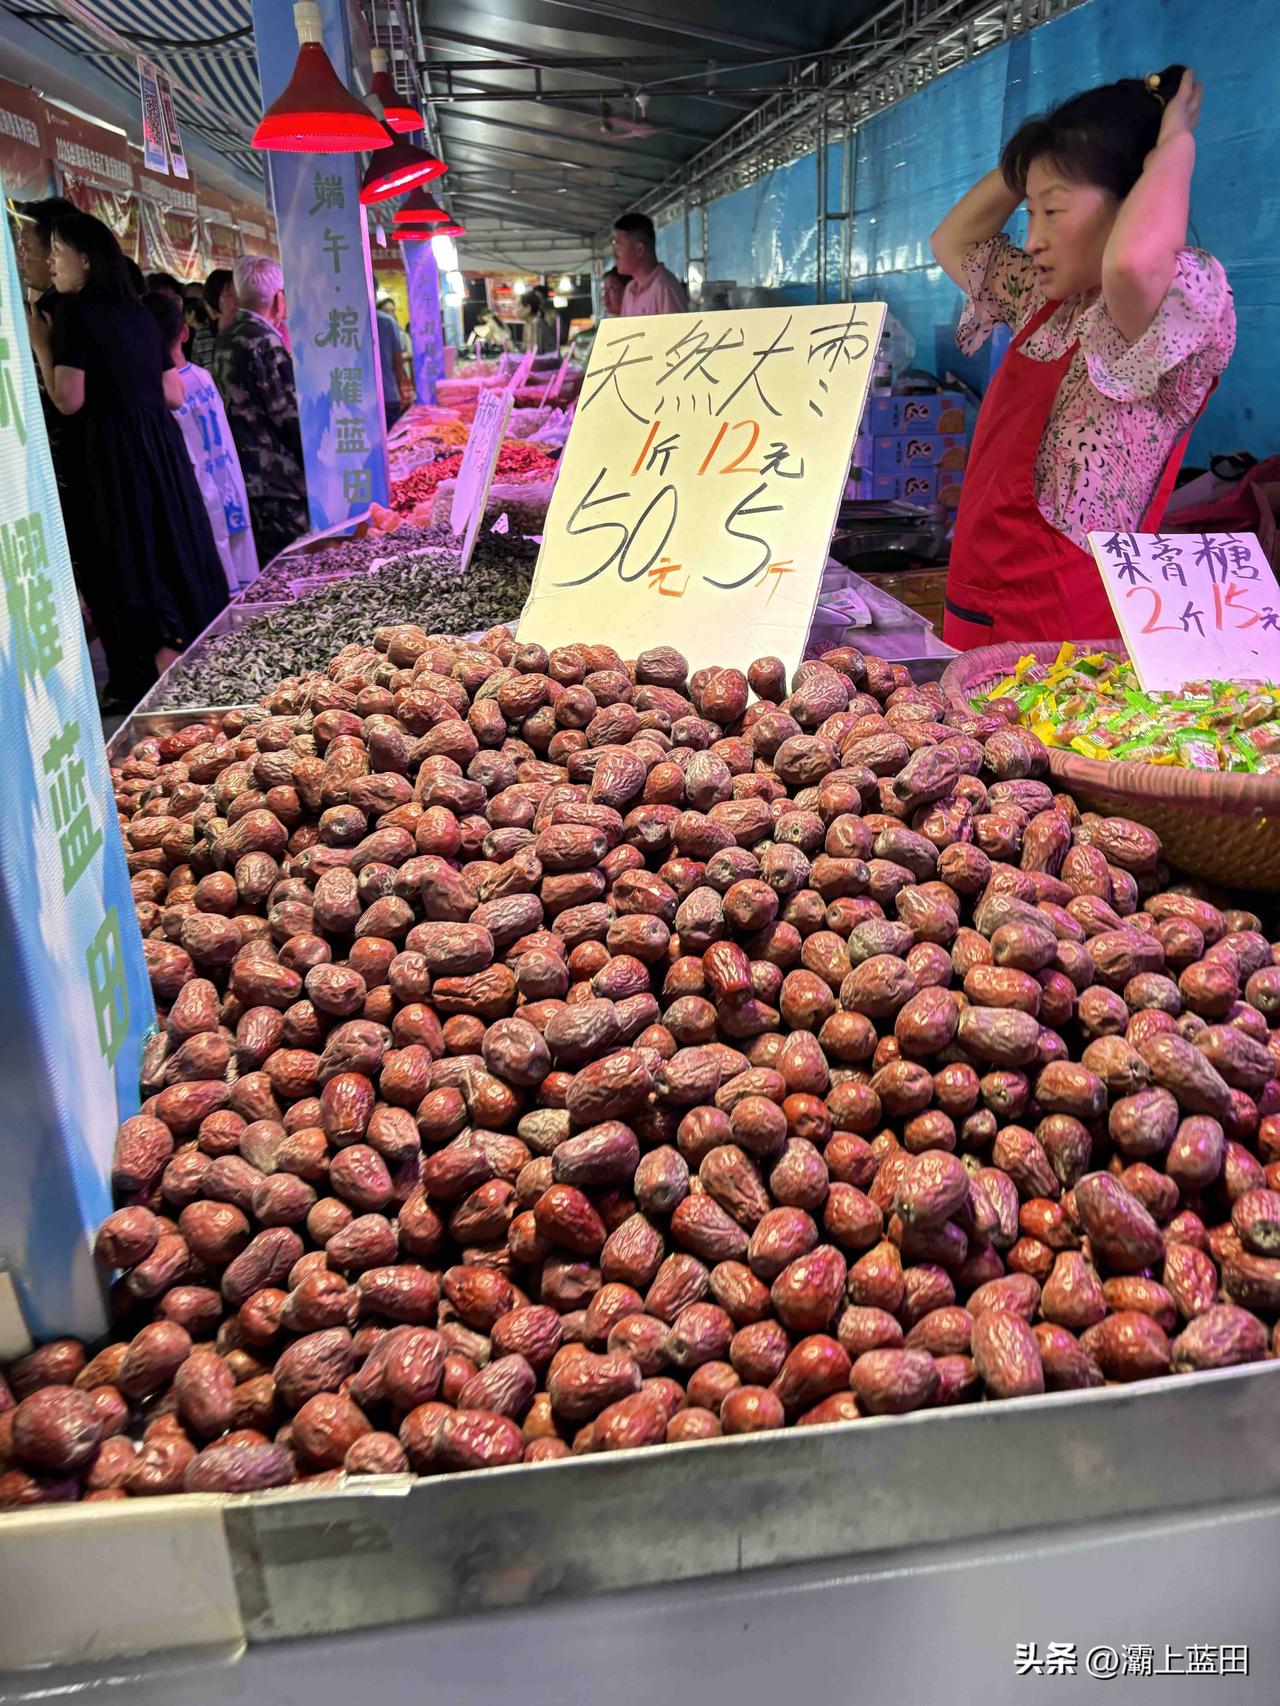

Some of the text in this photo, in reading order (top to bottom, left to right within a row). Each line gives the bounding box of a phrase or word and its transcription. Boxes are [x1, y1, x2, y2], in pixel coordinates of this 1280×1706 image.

[582, 304, 868, 424] 天然大枣
[1102, 533, 1263, 586] 梨膏糖
